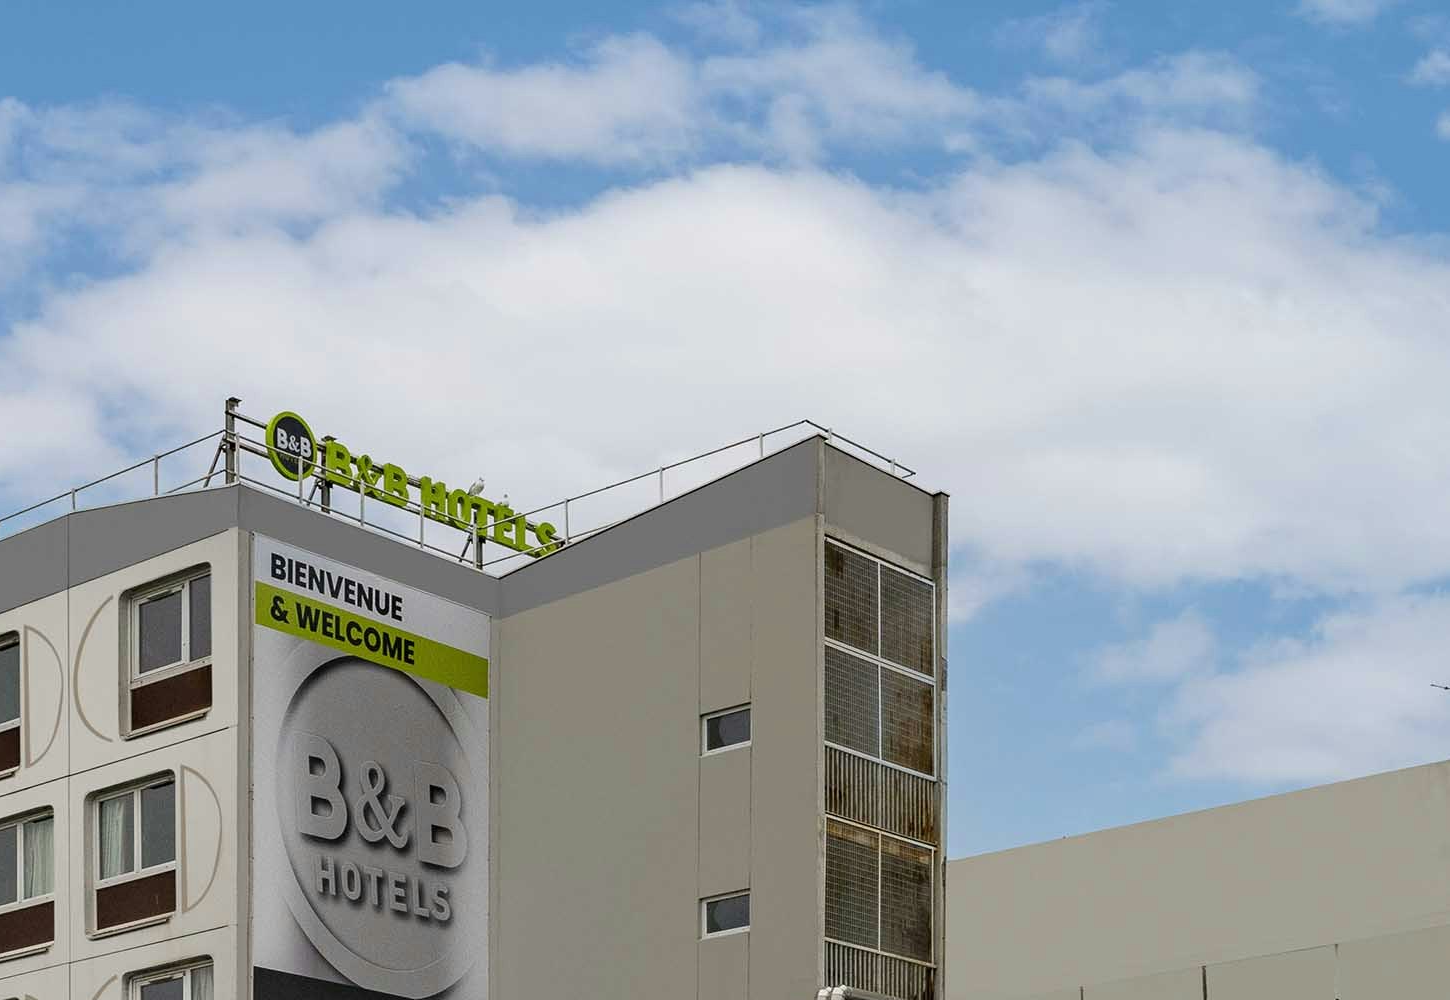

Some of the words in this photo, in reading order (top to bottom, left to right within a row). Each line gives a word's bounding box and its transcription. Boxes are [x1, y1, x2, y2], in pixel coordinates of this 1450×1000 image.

[277, 428, 312, 458] B&B
[326, 440, 409, 508] B&B
[420, 475, 557, 559] HOTELS
[270, 552, 403, 622] BIENVENUE
[270, 595, 290, 625] &
[295, 602, 415, 666] WELCOME
[294, 731, 470, 869] B&B
[313, 855, 452, 922] HOTELS
